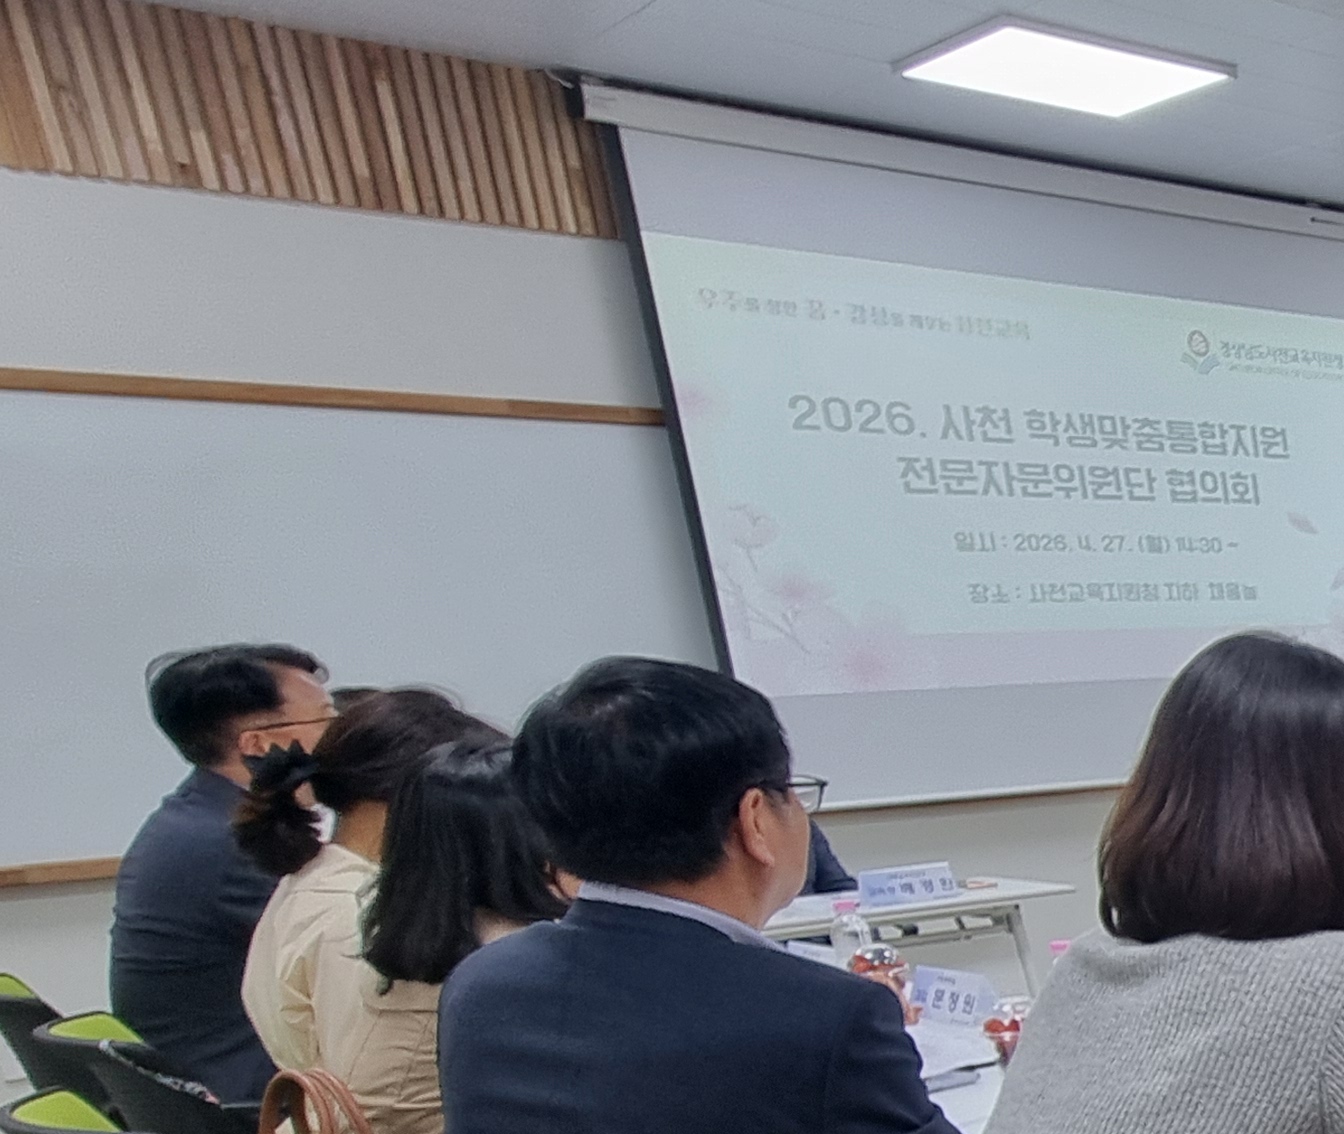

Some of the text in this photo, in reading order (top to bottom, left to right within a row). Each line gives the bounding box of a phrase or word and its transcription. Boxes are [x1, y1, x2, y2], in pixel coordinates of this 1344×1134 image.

[787, 393, 1291, 460] 2026. 사천 학생맞춤통합지원
[897, 456, 1262, 507] 전문자문위원단 협의회
